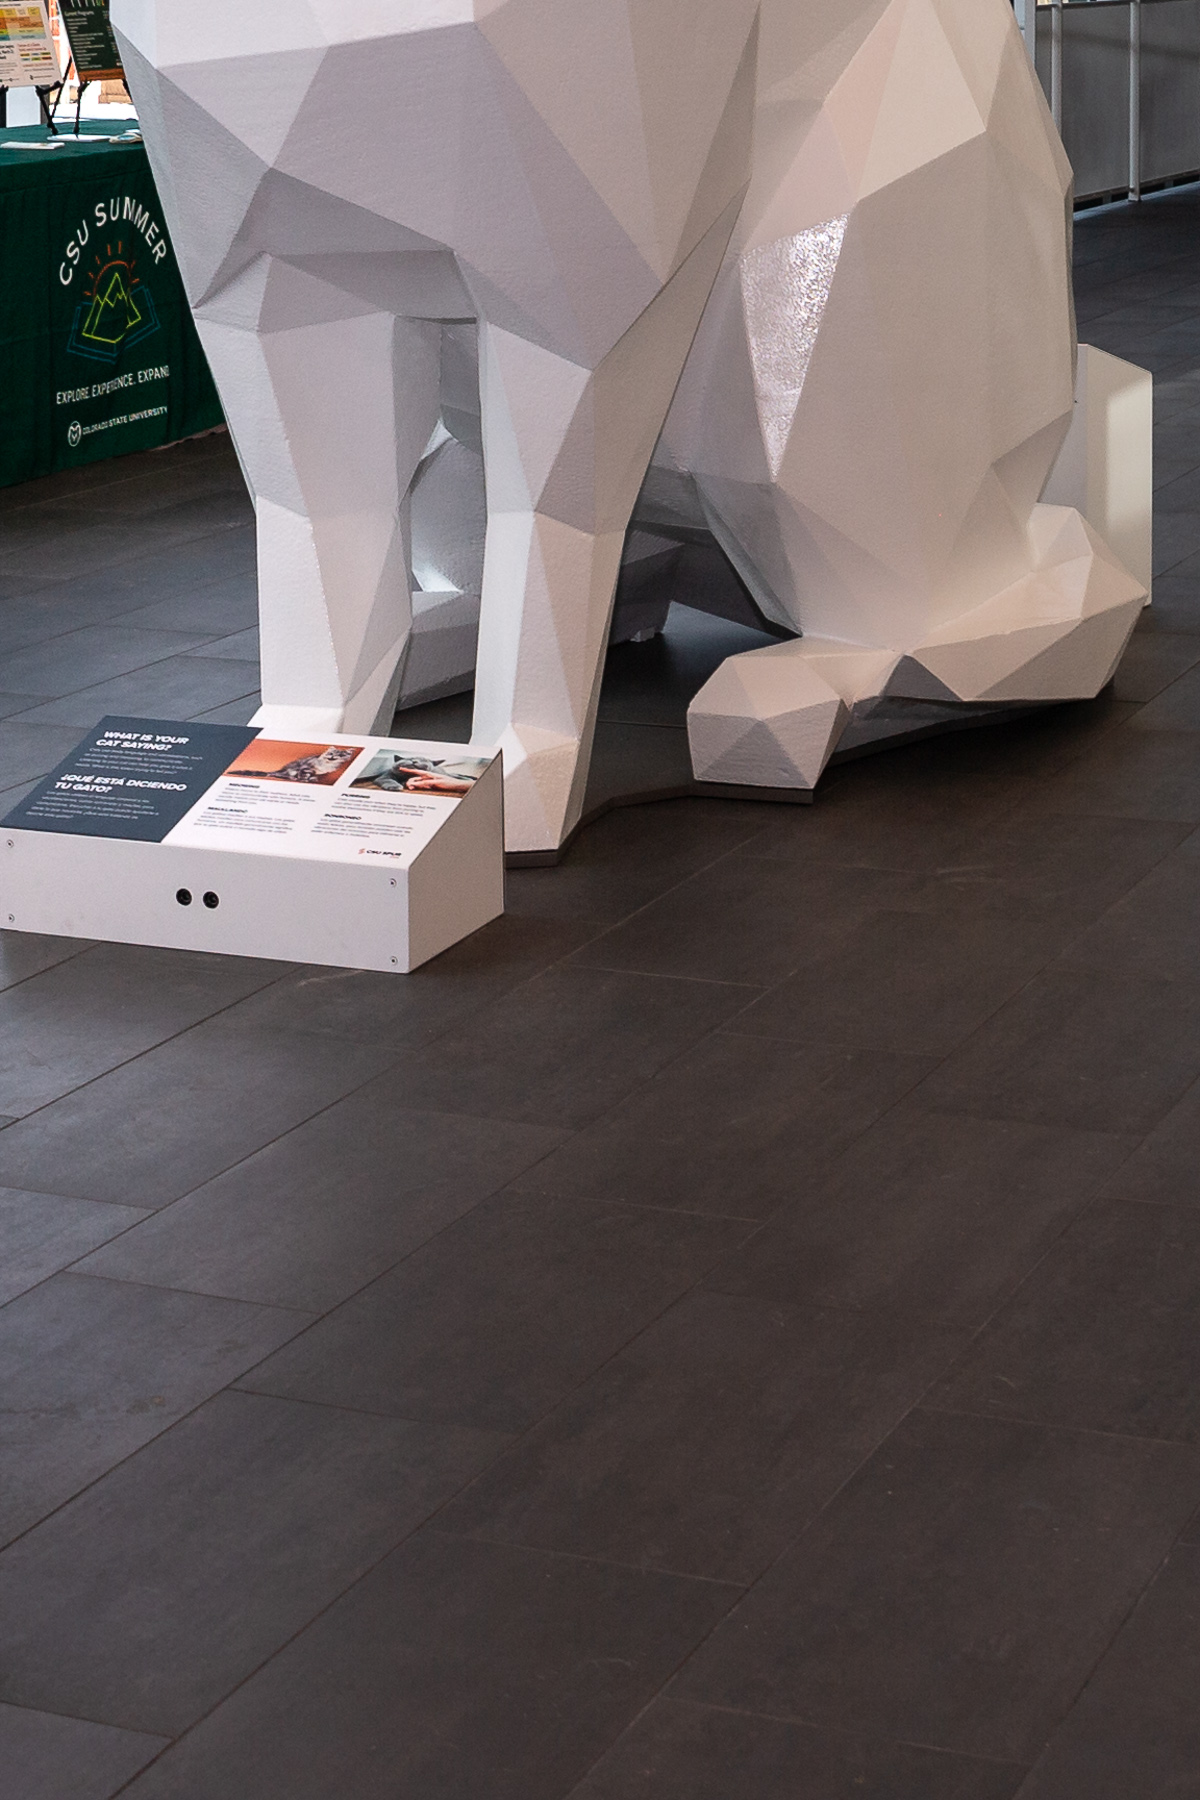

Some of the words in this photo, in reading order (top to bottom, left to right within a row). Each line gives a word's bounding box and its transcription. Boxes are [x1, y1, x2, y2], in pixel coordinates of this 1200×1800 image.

[59, 219, 89, 286] CSU
[94, 195, 167, 265] SUMMER
[108, 414, 128, 428] STATE
[128, 406, 168, 422] UNIVERSITY
[96, 739, 122, 747] CAT
[120, 740, 172, 751] SAYING?
[104, 731, 139, 741] WHAT
[139, 733, 153, 742] IS
[155, 735, 190, 745] YOUR
[55, 782, 72, 790] TU
[72, 784, 113, 794] GATO?
[60, 772, 95, 783] ¿QUÉ
[93, 776, 126, 786] ESTÁ
[126, 779, 188, 792] DICIENDO
